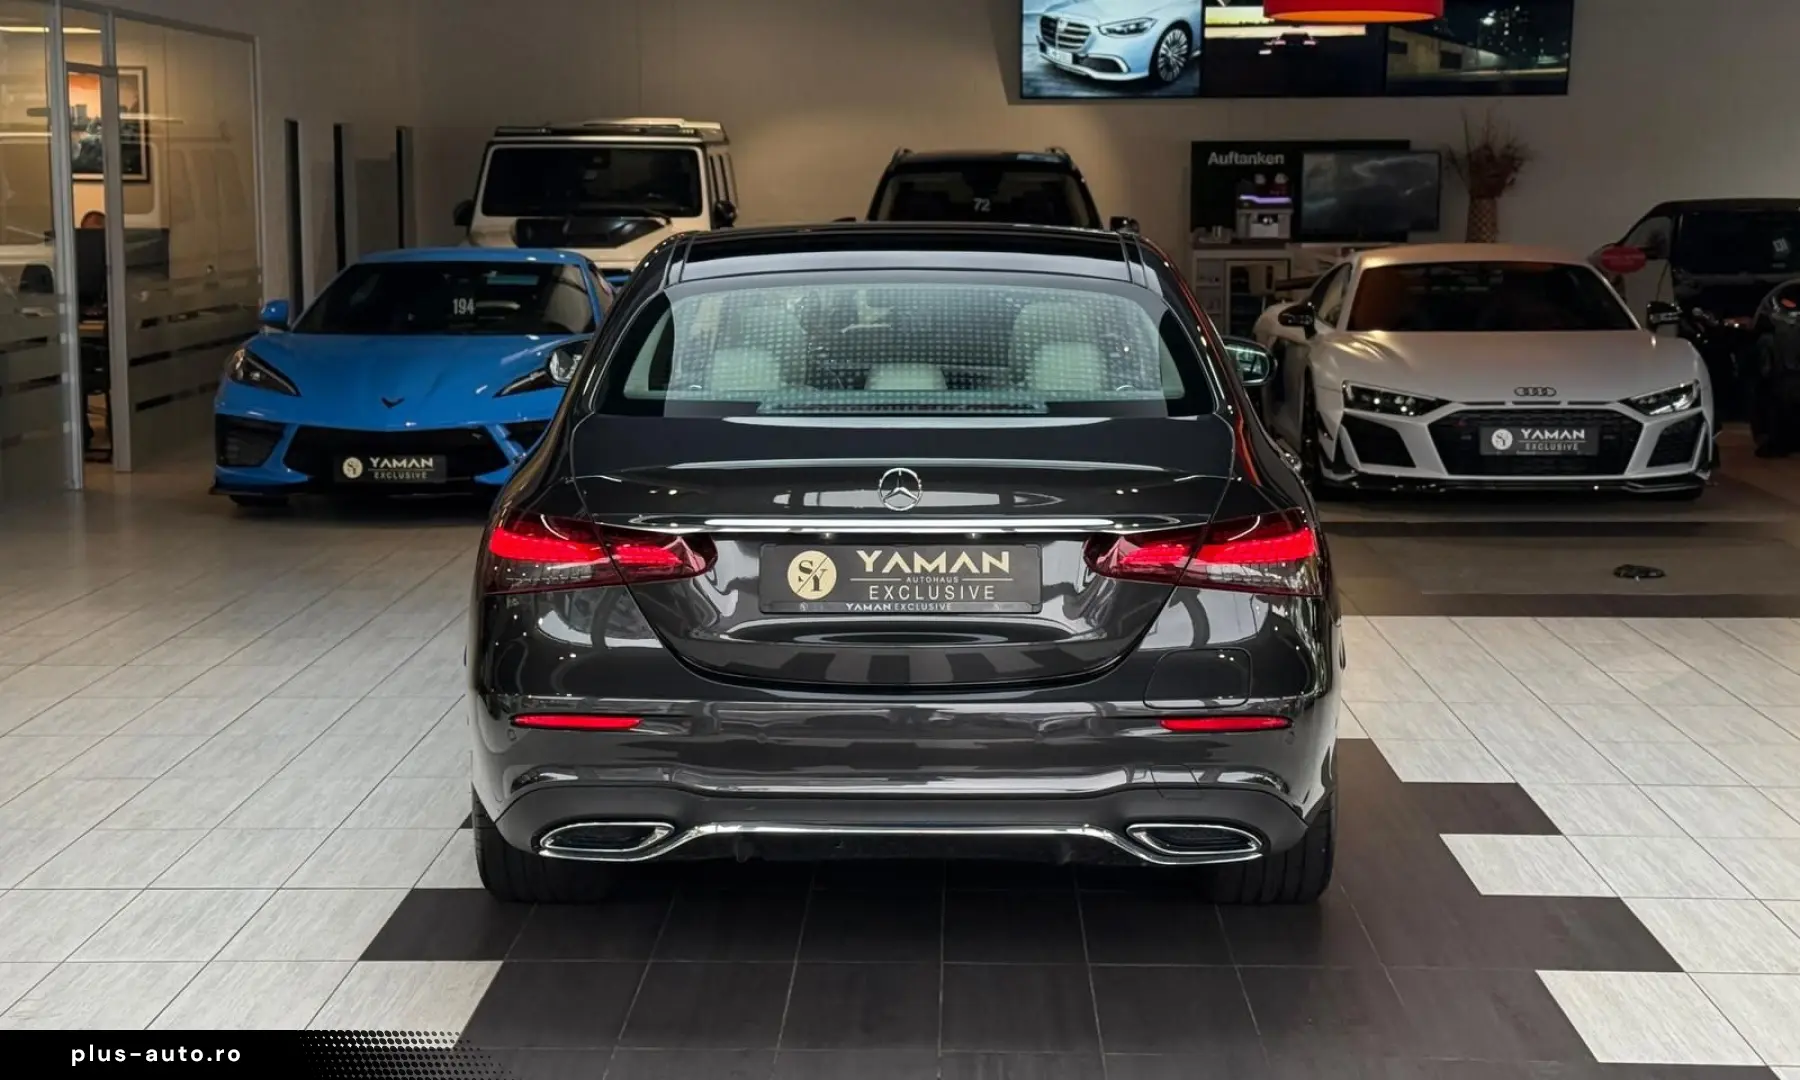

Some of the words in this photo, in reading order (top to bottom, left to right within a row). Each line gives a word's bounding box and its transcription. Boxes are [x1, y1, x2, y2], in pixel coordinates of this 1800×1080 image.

[1207, 151, 1285, 166] Auftanken
[973, 197, 991, 212] 72
[452, 298, 475, 315] 194
[1520, 428, 1585, 440] YAMAN
[1525, 443, 1579, 451] EXCLUSIVE
[369, 457, 434, 469] YAMAN
[373, 471, 429, 480] EXCLUSIVE
[856, 550, 1010, 574] YAMAN
[906, 576, 960, 584] AUTOHAUS
[869, 585, 996, 600] EXCLUSIVE
[845, 602, 892, 612] YAMAN
[894, 602, 953, 612] EXCLUSIVE
